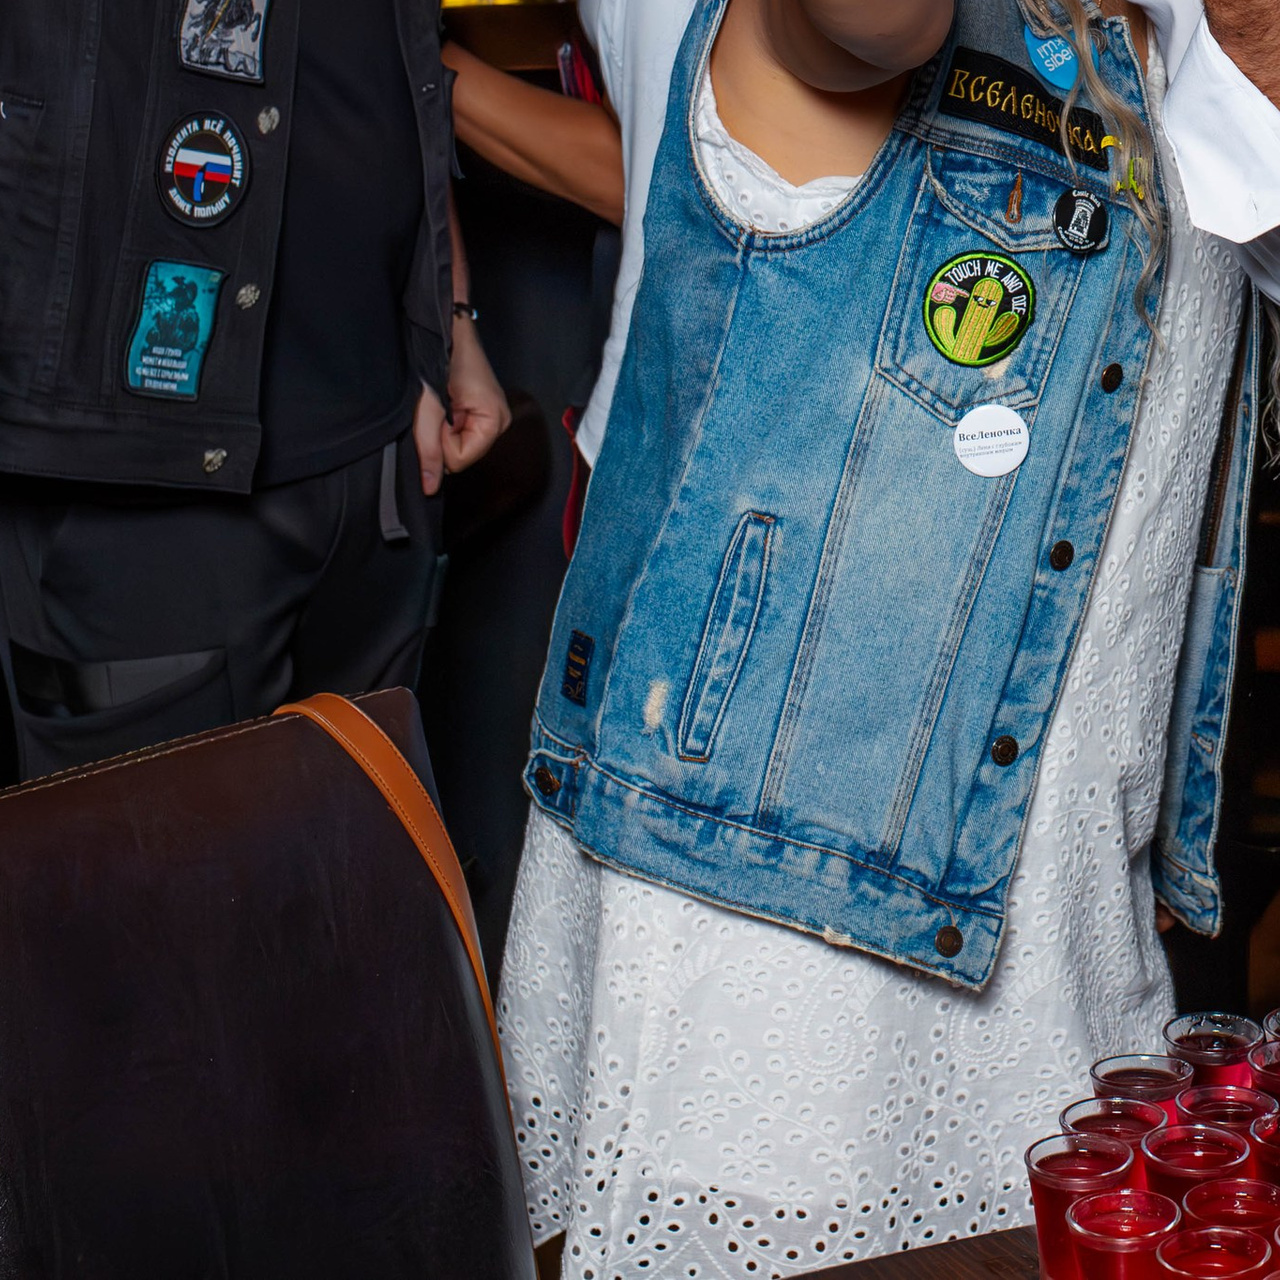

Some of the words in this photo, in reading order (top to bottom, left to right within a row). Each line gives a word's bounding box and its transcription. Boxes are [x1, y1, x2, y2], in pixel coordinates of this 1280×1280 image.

[164, 119, 200, 173] ИЗОЛЕНТА
[222, 129, 243, 187] ПОЧИНИТ
[193, 192, 231, 219] ПОЛЬШУ
[944, 259, 981, 286] TOUCH
[984, 259, 1004, 279] ME
[1000, 271, 1023, 294] AND
[1011, 294, 1027, 315] DIE
[958, 427, 1022, 442] ВсеЛеночка
